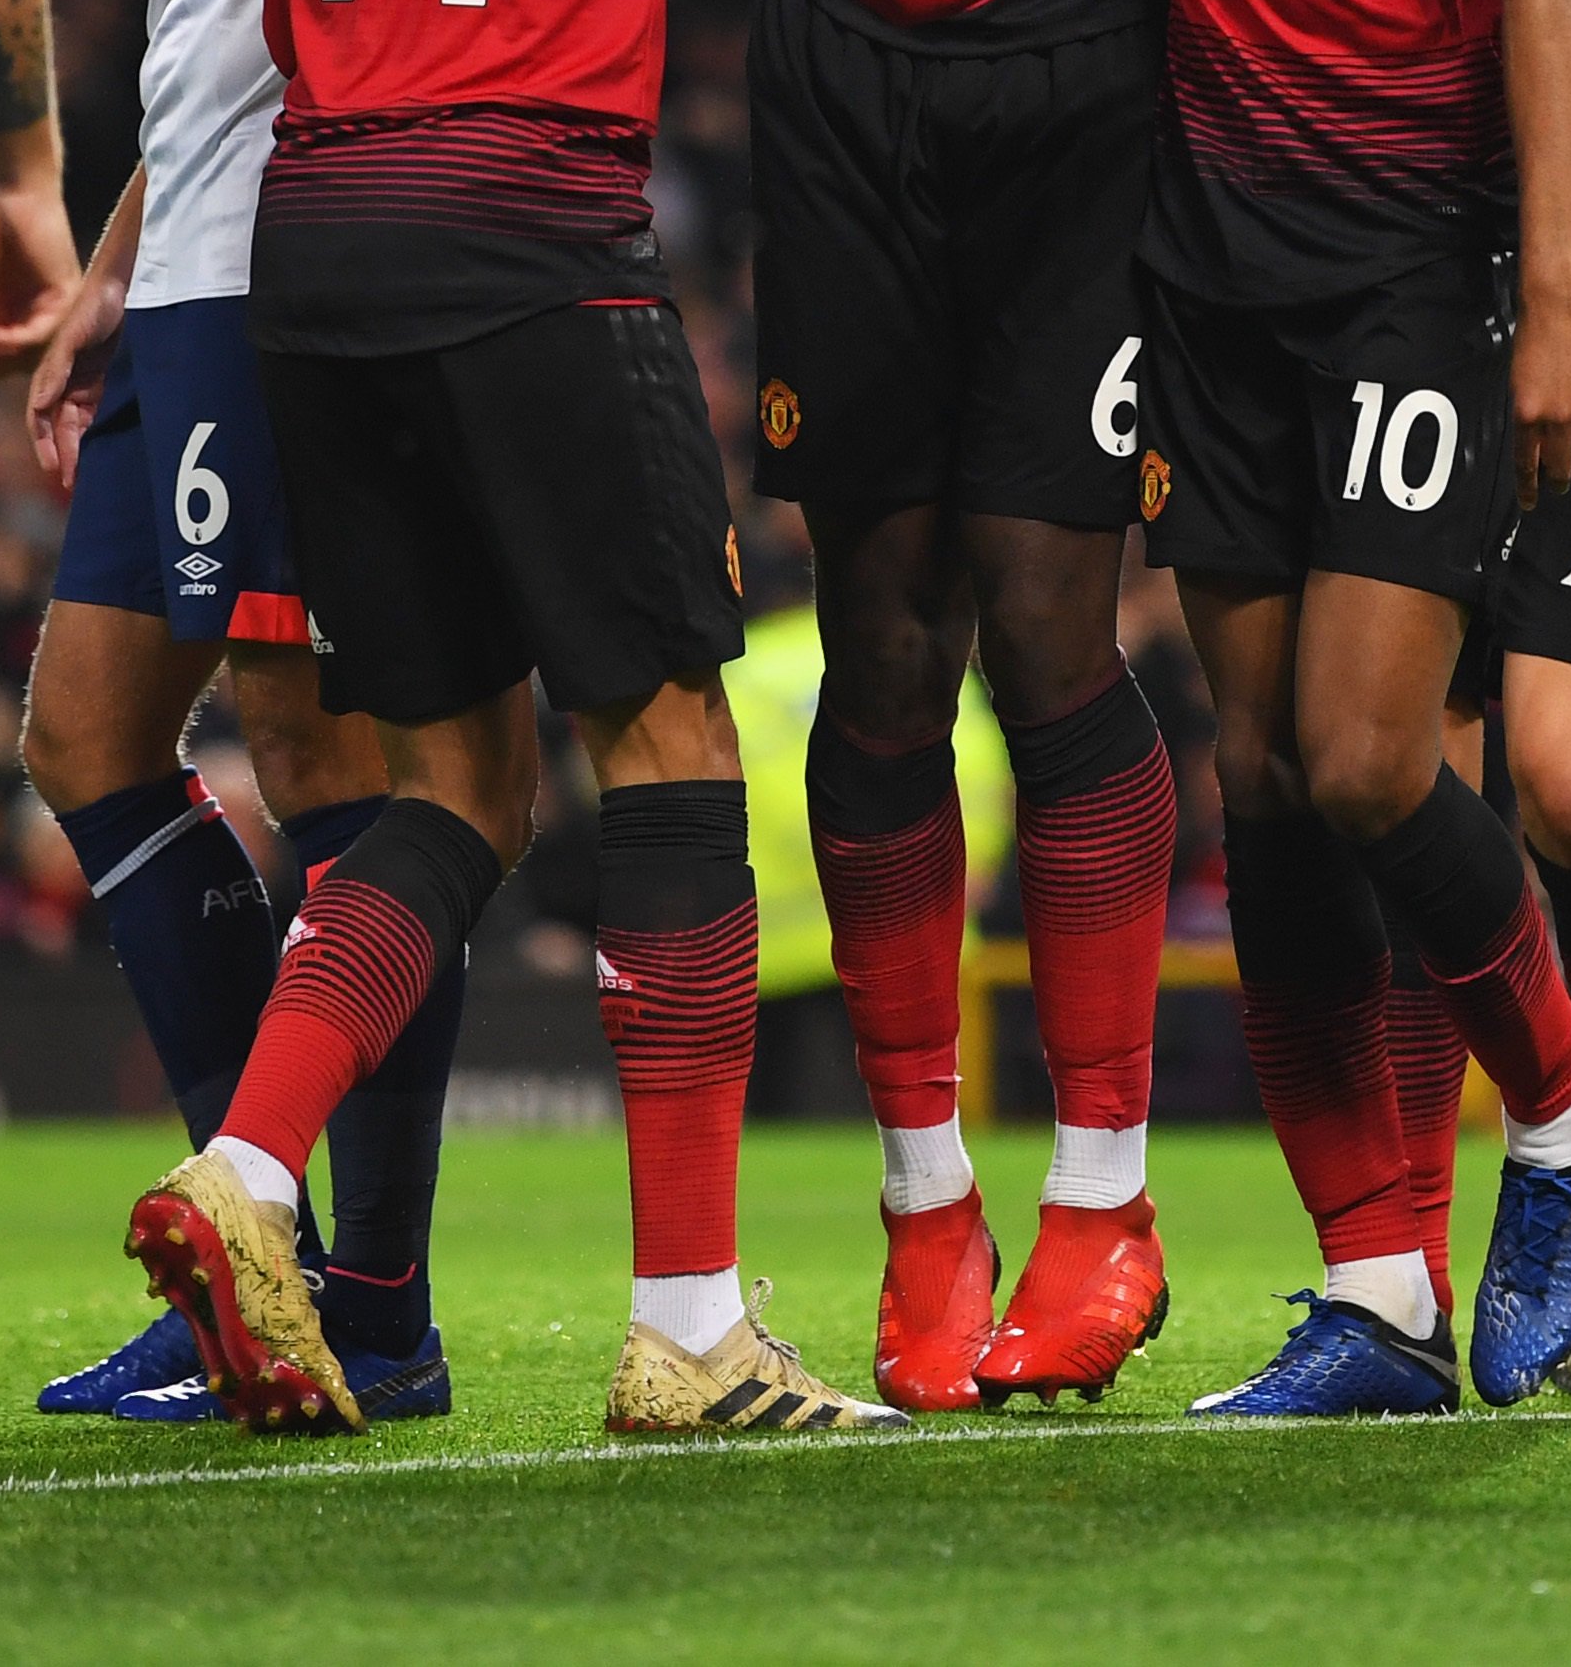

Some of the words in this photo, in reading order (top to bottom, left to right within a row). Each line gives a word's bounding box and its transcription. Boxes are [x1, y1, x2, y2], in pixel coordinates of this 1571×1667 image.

[1091, 335, 1142, 458] 6
[1342, 380, 1459, 512] 10
[175, 422, 229, 545] 6
[179, 581, 217, 596] umbro
